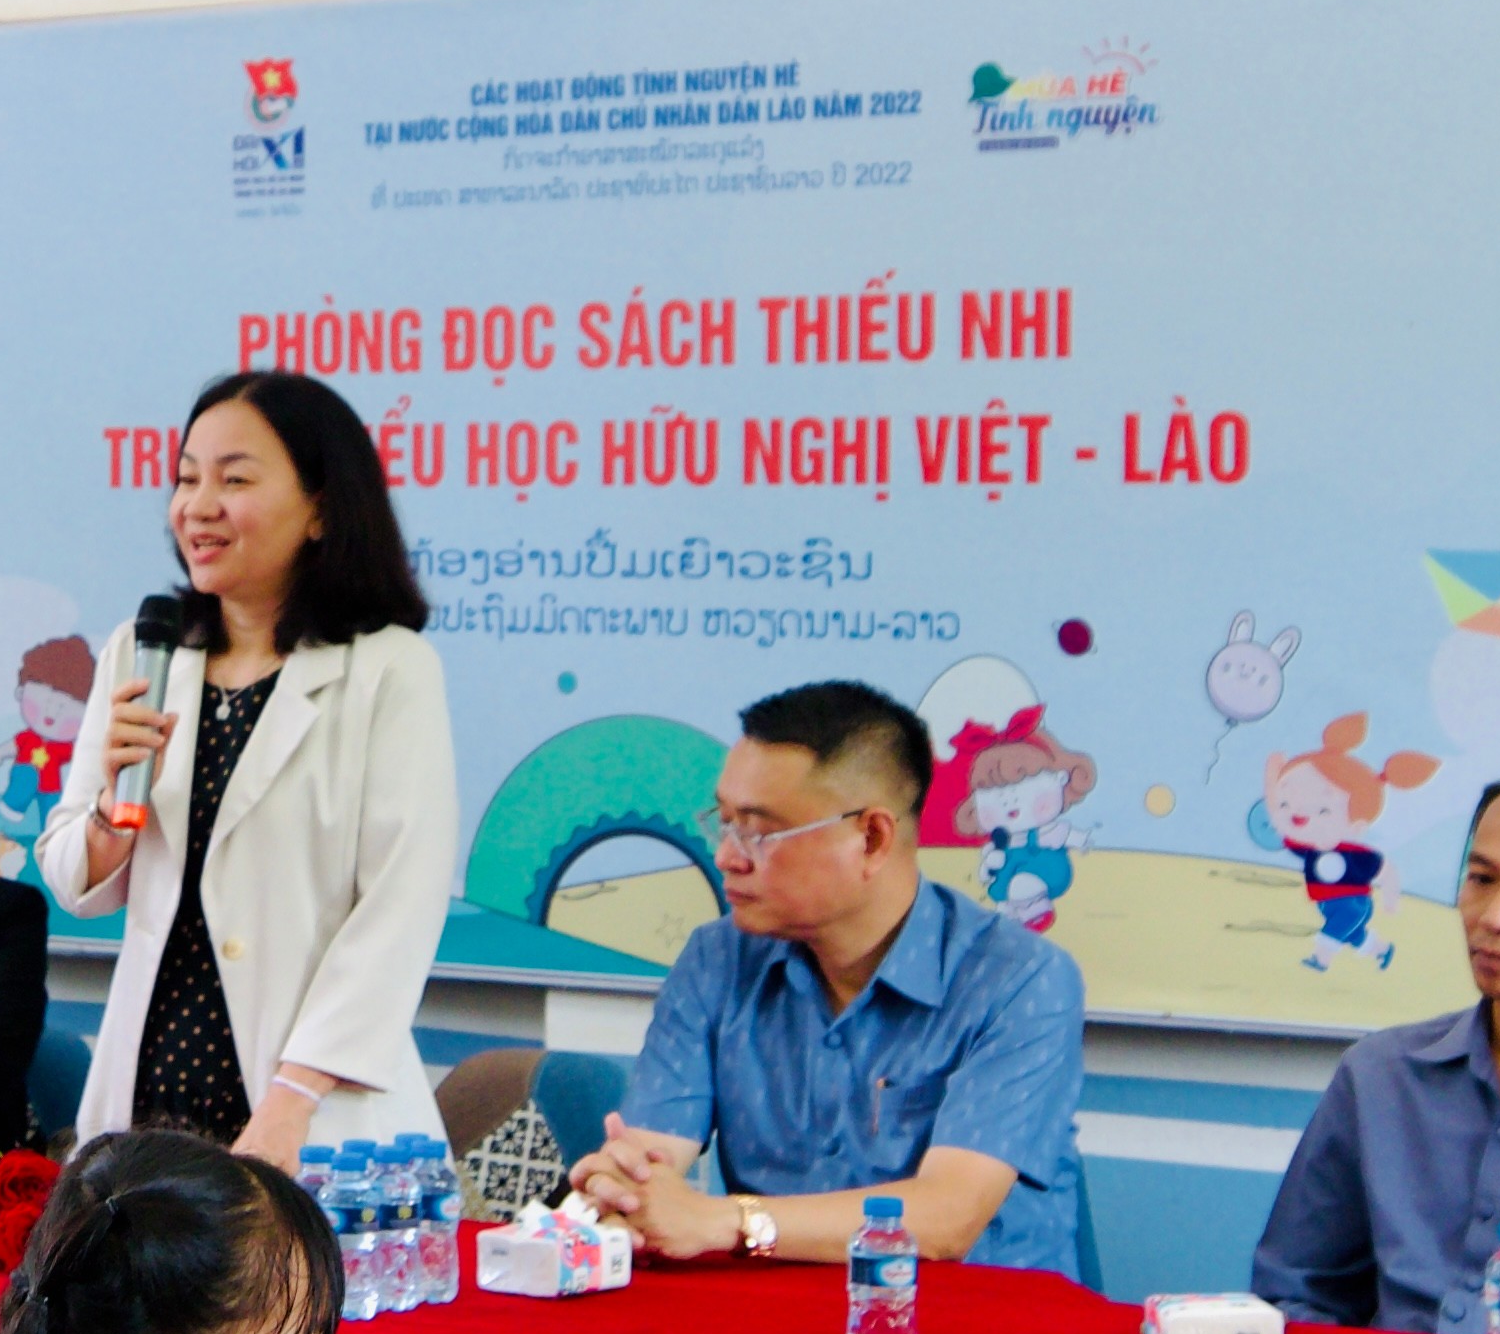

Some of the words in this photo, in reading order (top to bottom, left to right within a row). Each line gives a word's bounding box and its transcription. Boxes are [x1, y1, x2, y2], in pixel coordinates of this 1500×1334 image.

[855, 161, 912, 186] 2022
[238, 294, 421, 375] PHÒNG
[440, 305, 556, 387] ĐỌC
[578, 286, 737, 371] SÁCH
[756, 269, 937, 367] THIẾU
[959, 286, 1073, 359] NHI
[464, 417, 577, 505] HỌC
[601, 405, 721, 487] HỮU
[742, 414, 893, 503] NGHỊ
[915, 399, 1052, 505] VIỆT
[1121, 397, 1250, 485] LÀO
